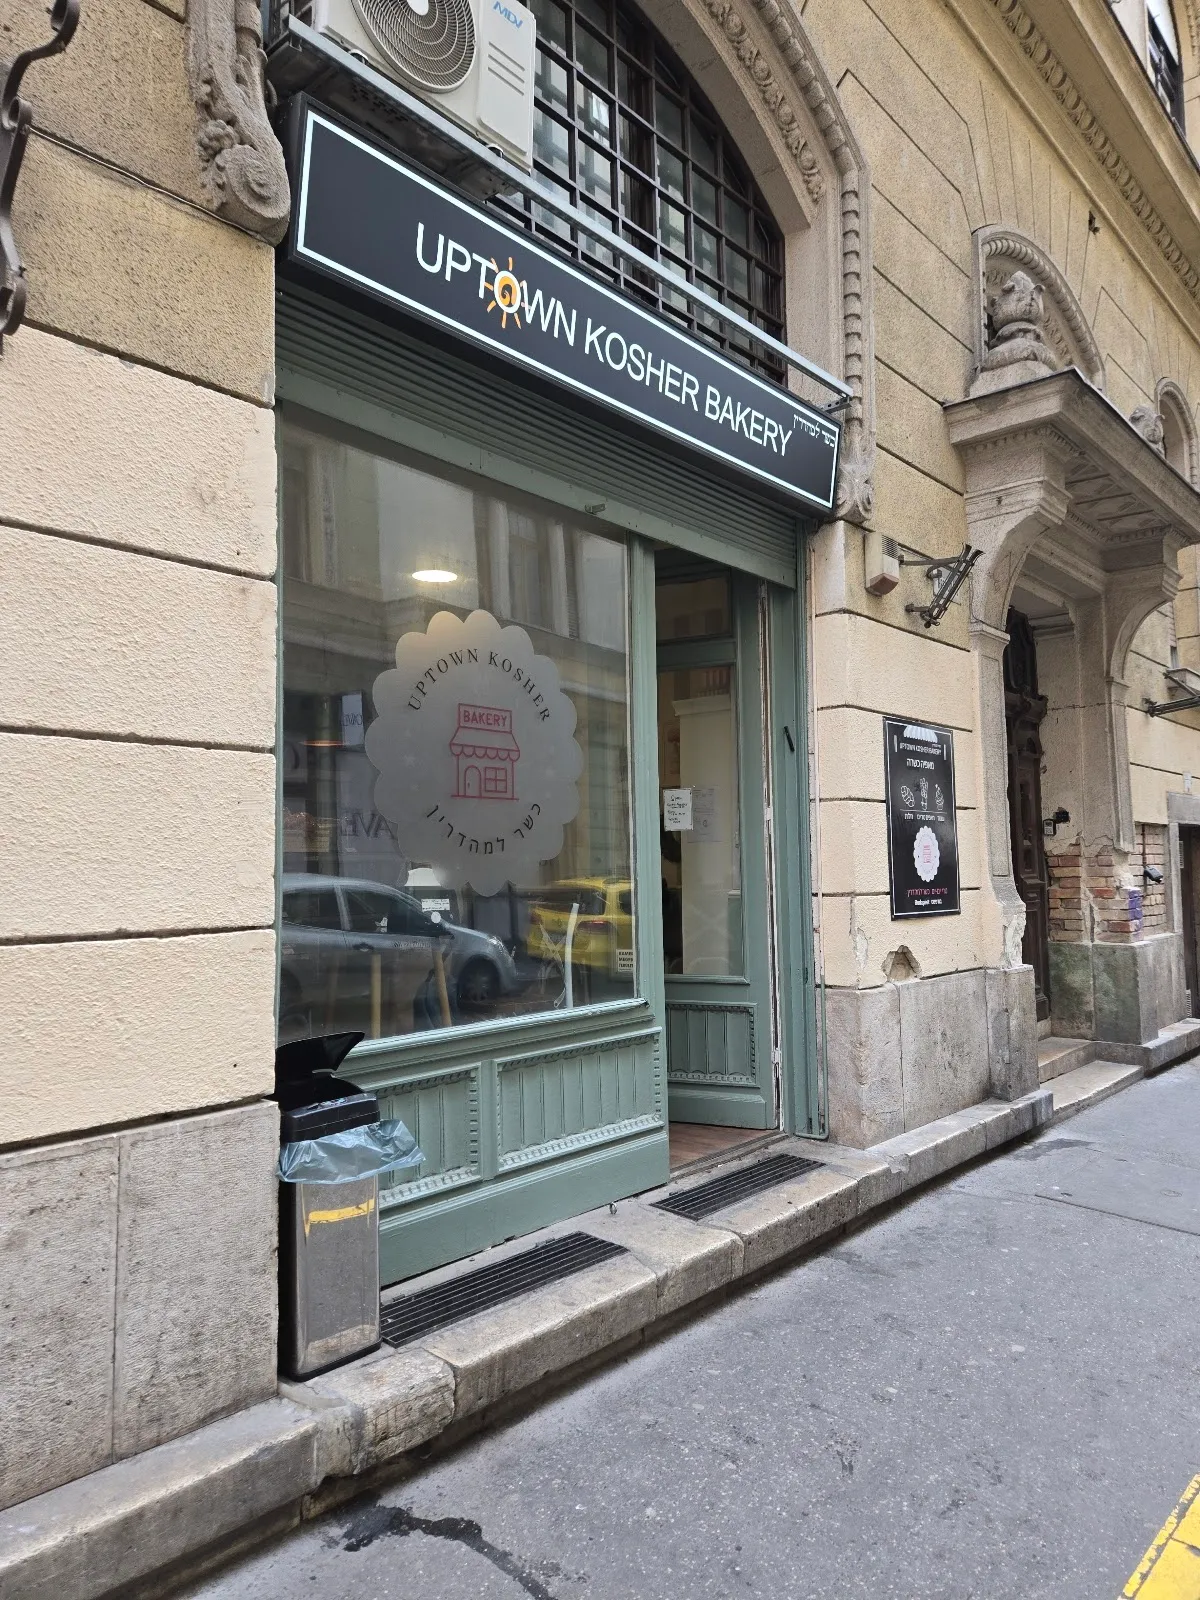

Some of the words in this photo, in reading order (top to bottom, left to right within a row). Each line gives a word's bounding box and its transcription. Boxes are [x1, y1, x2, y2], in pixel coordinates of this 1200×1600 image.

[493, 1, 523, 28] MDV
[416, 222, 577, 347] UPTOWN
[584, 318, 699, 412] KOSHER
[705, 385, 792, 456] BAKERY
[408, 648, 480, 711] UPTOWN
[488, 651, 550, 721] KOSHER
[463, 710, 508, 727] BAKERY
[426, 804, 505, 855] למהדרין
[514, 803, 541, 838] כשר
